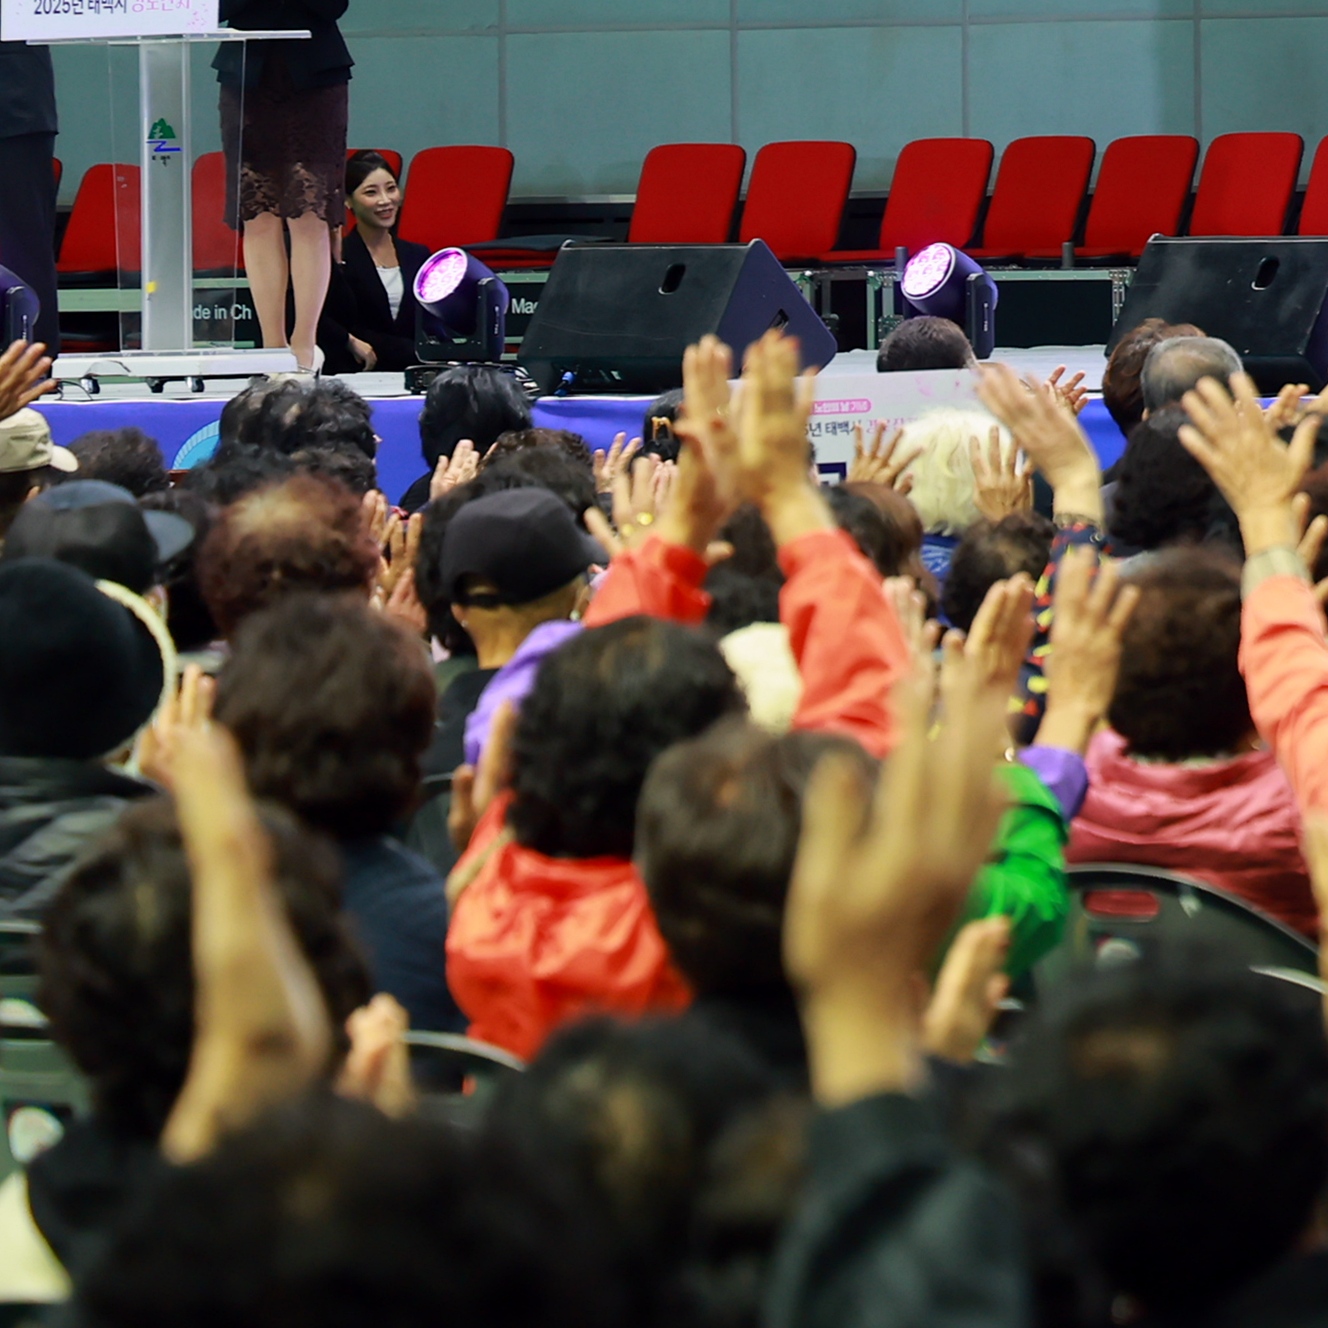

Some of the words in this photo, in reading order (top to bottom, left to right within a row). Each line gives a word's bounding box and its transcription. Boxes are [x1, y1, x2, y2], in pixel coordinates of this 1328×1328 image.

[193, 304, 211, 320] de
[214, 304, 227, 320] in
[511, 297, 539, 314] Ma
